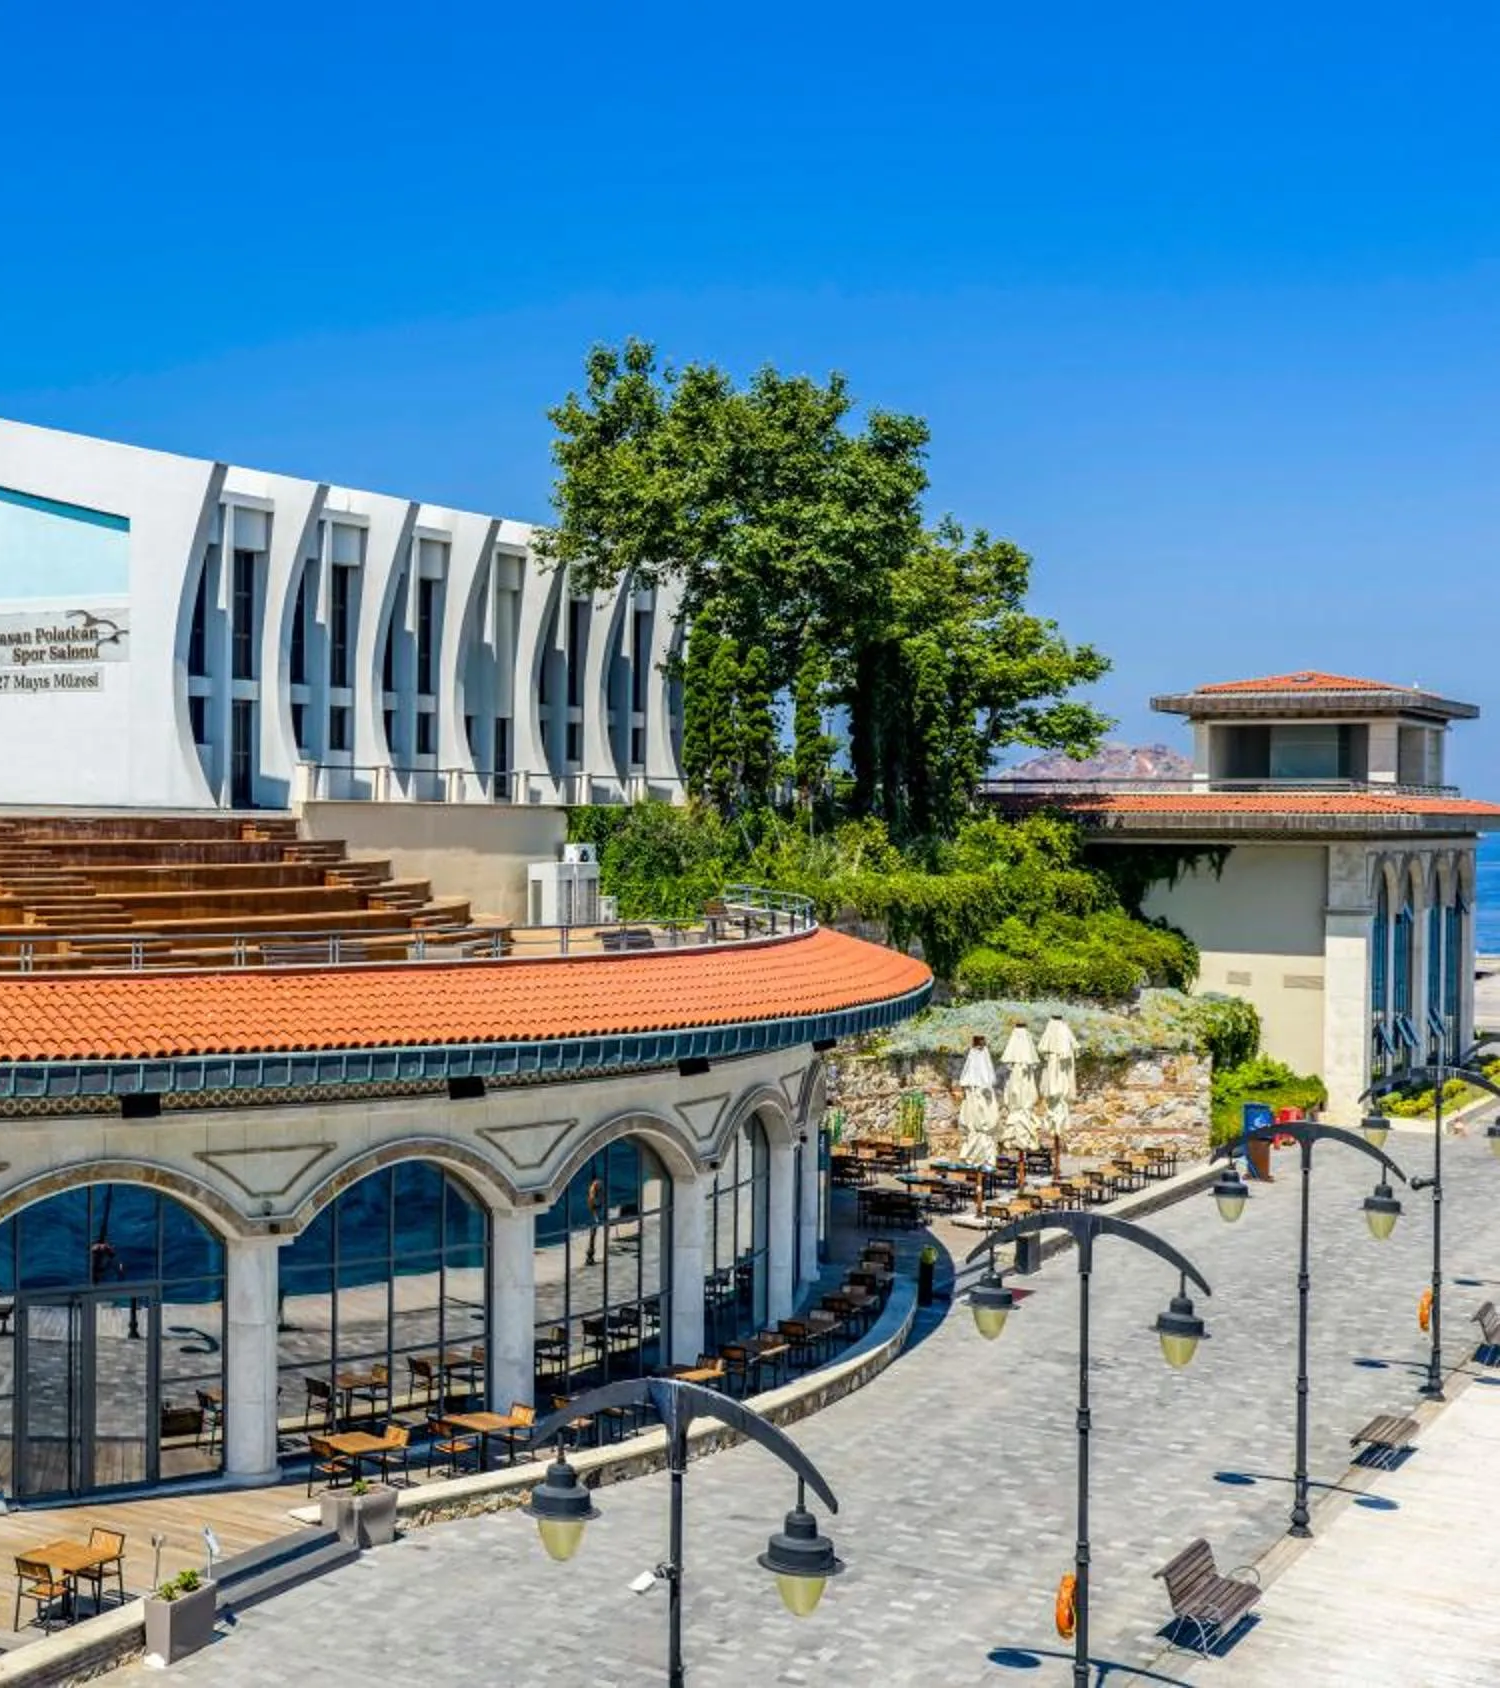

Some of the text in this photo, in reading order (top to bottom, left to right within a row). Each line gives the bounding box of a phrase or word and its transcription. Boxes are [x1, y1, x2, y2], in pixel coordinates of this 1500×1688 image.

[35, 624, 99, 644] Polatkan
[12, 644, 99, 666] Spor Salonu
[53, 672, 99, 689] Müzesi
